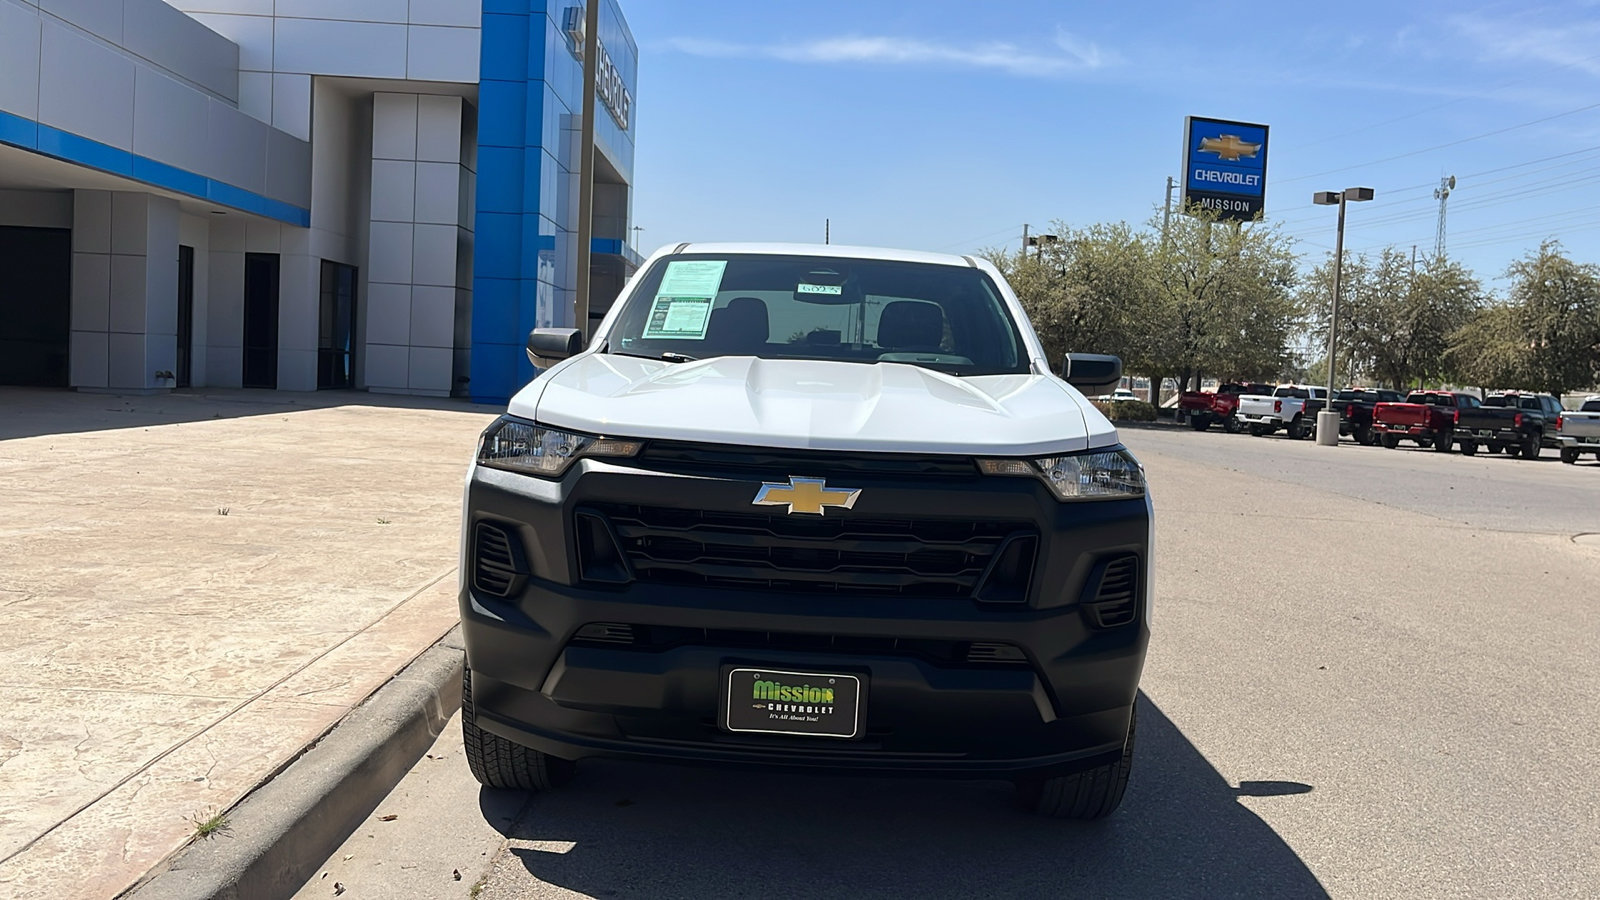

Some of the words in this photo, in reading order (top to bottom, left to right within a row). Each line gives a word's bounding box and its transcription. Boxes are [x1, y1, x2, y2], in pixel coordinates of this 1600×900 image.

[1194, 169, 1260, 186] CHEVROLET
[1201, 197, 1250, 212] MISSION
[753, 680, 834, 704] Mission
[767, 703, 834, 714] CHEVROLET
